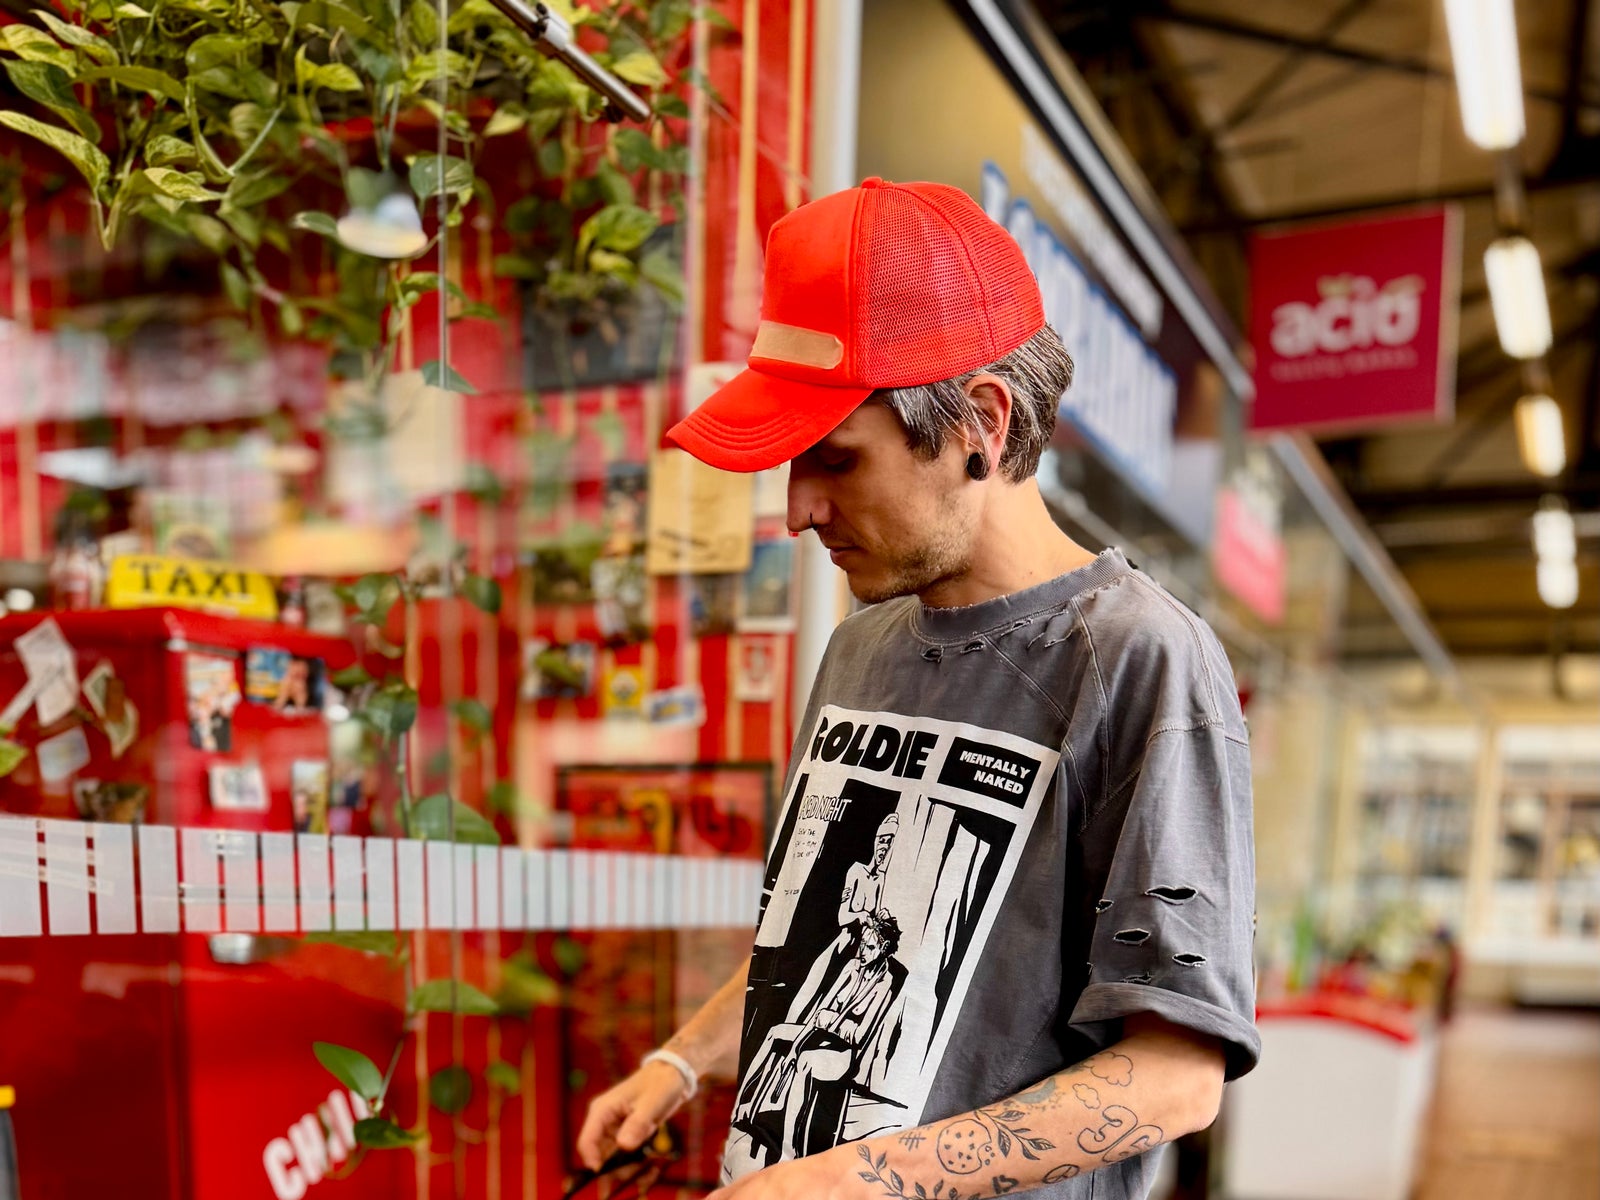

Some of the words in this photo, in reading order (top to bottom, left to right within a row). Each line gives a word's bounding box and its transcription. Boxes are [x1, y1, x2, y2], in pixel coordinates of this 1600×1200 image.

[128, 560, 248, 597] TAXI
[811, 717, 939, 780] GOLDIE
[960, 750, 1031, 779] MENTALLY
[973, 769, 1025, 795] NAKED
